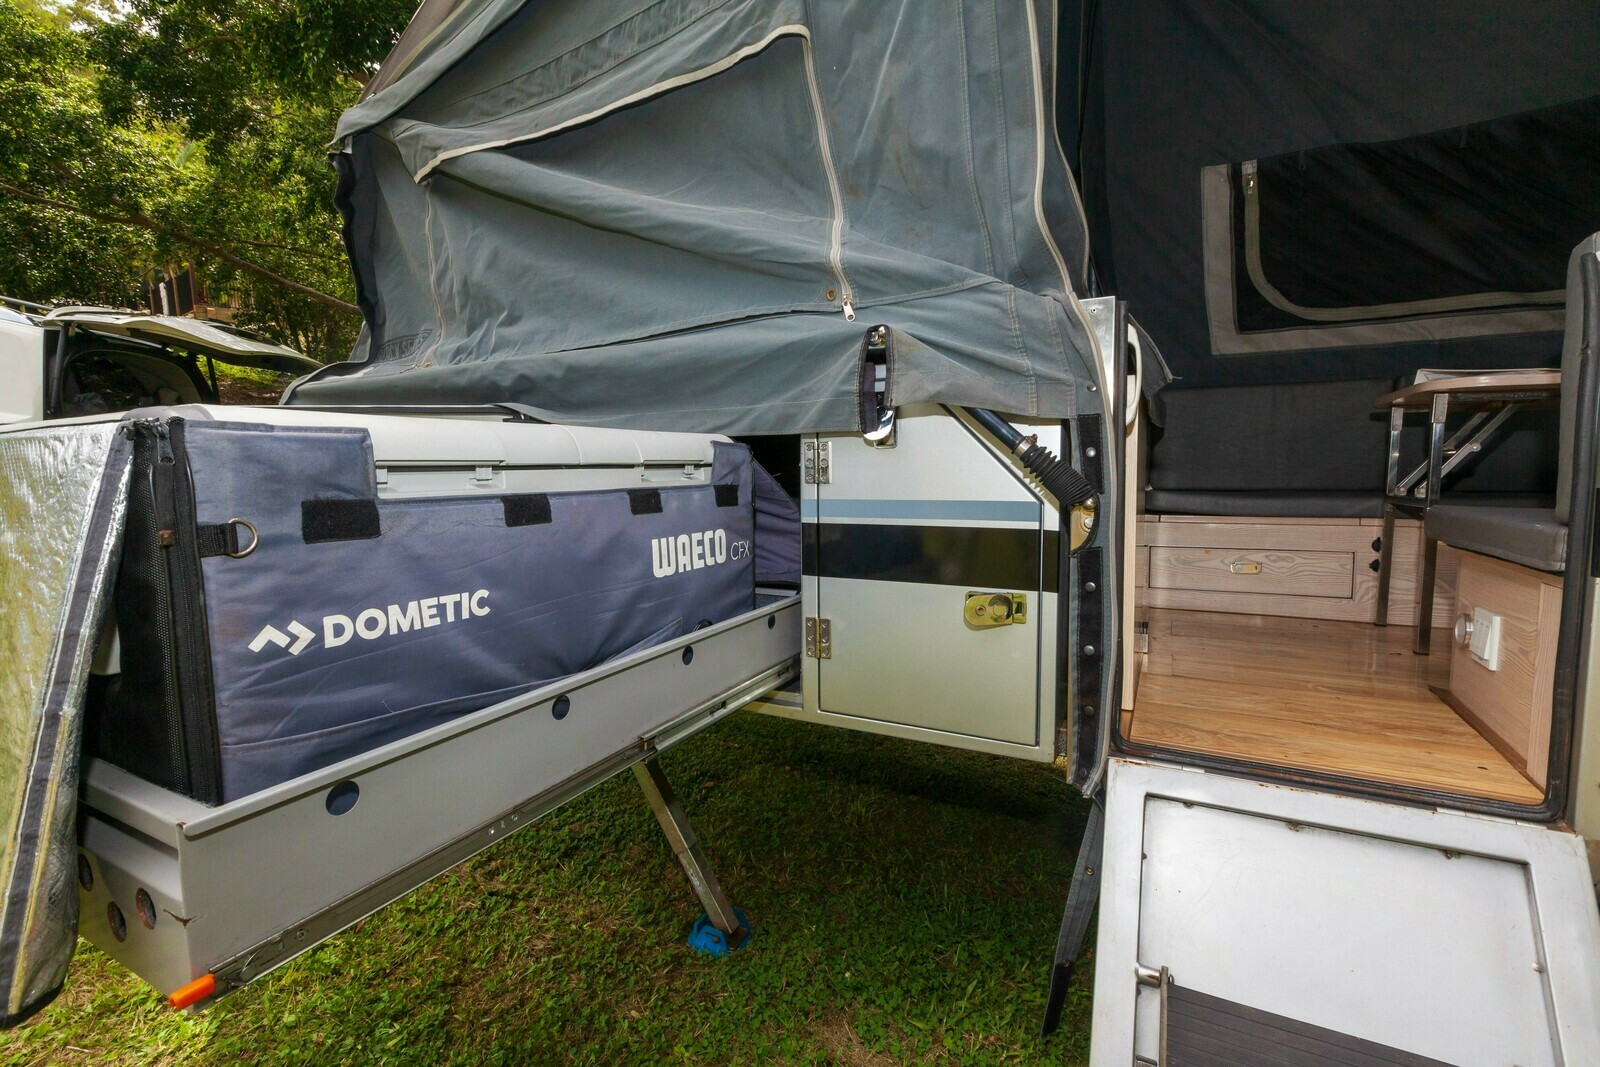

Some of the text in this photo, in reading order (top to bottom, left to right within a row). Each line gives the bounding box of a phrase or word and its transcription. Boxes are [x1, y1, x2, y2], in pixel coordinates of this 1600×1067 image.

[651, 528, 750, 578] WAECO CFX
[322, 589, 491, 649] DOMETIC
